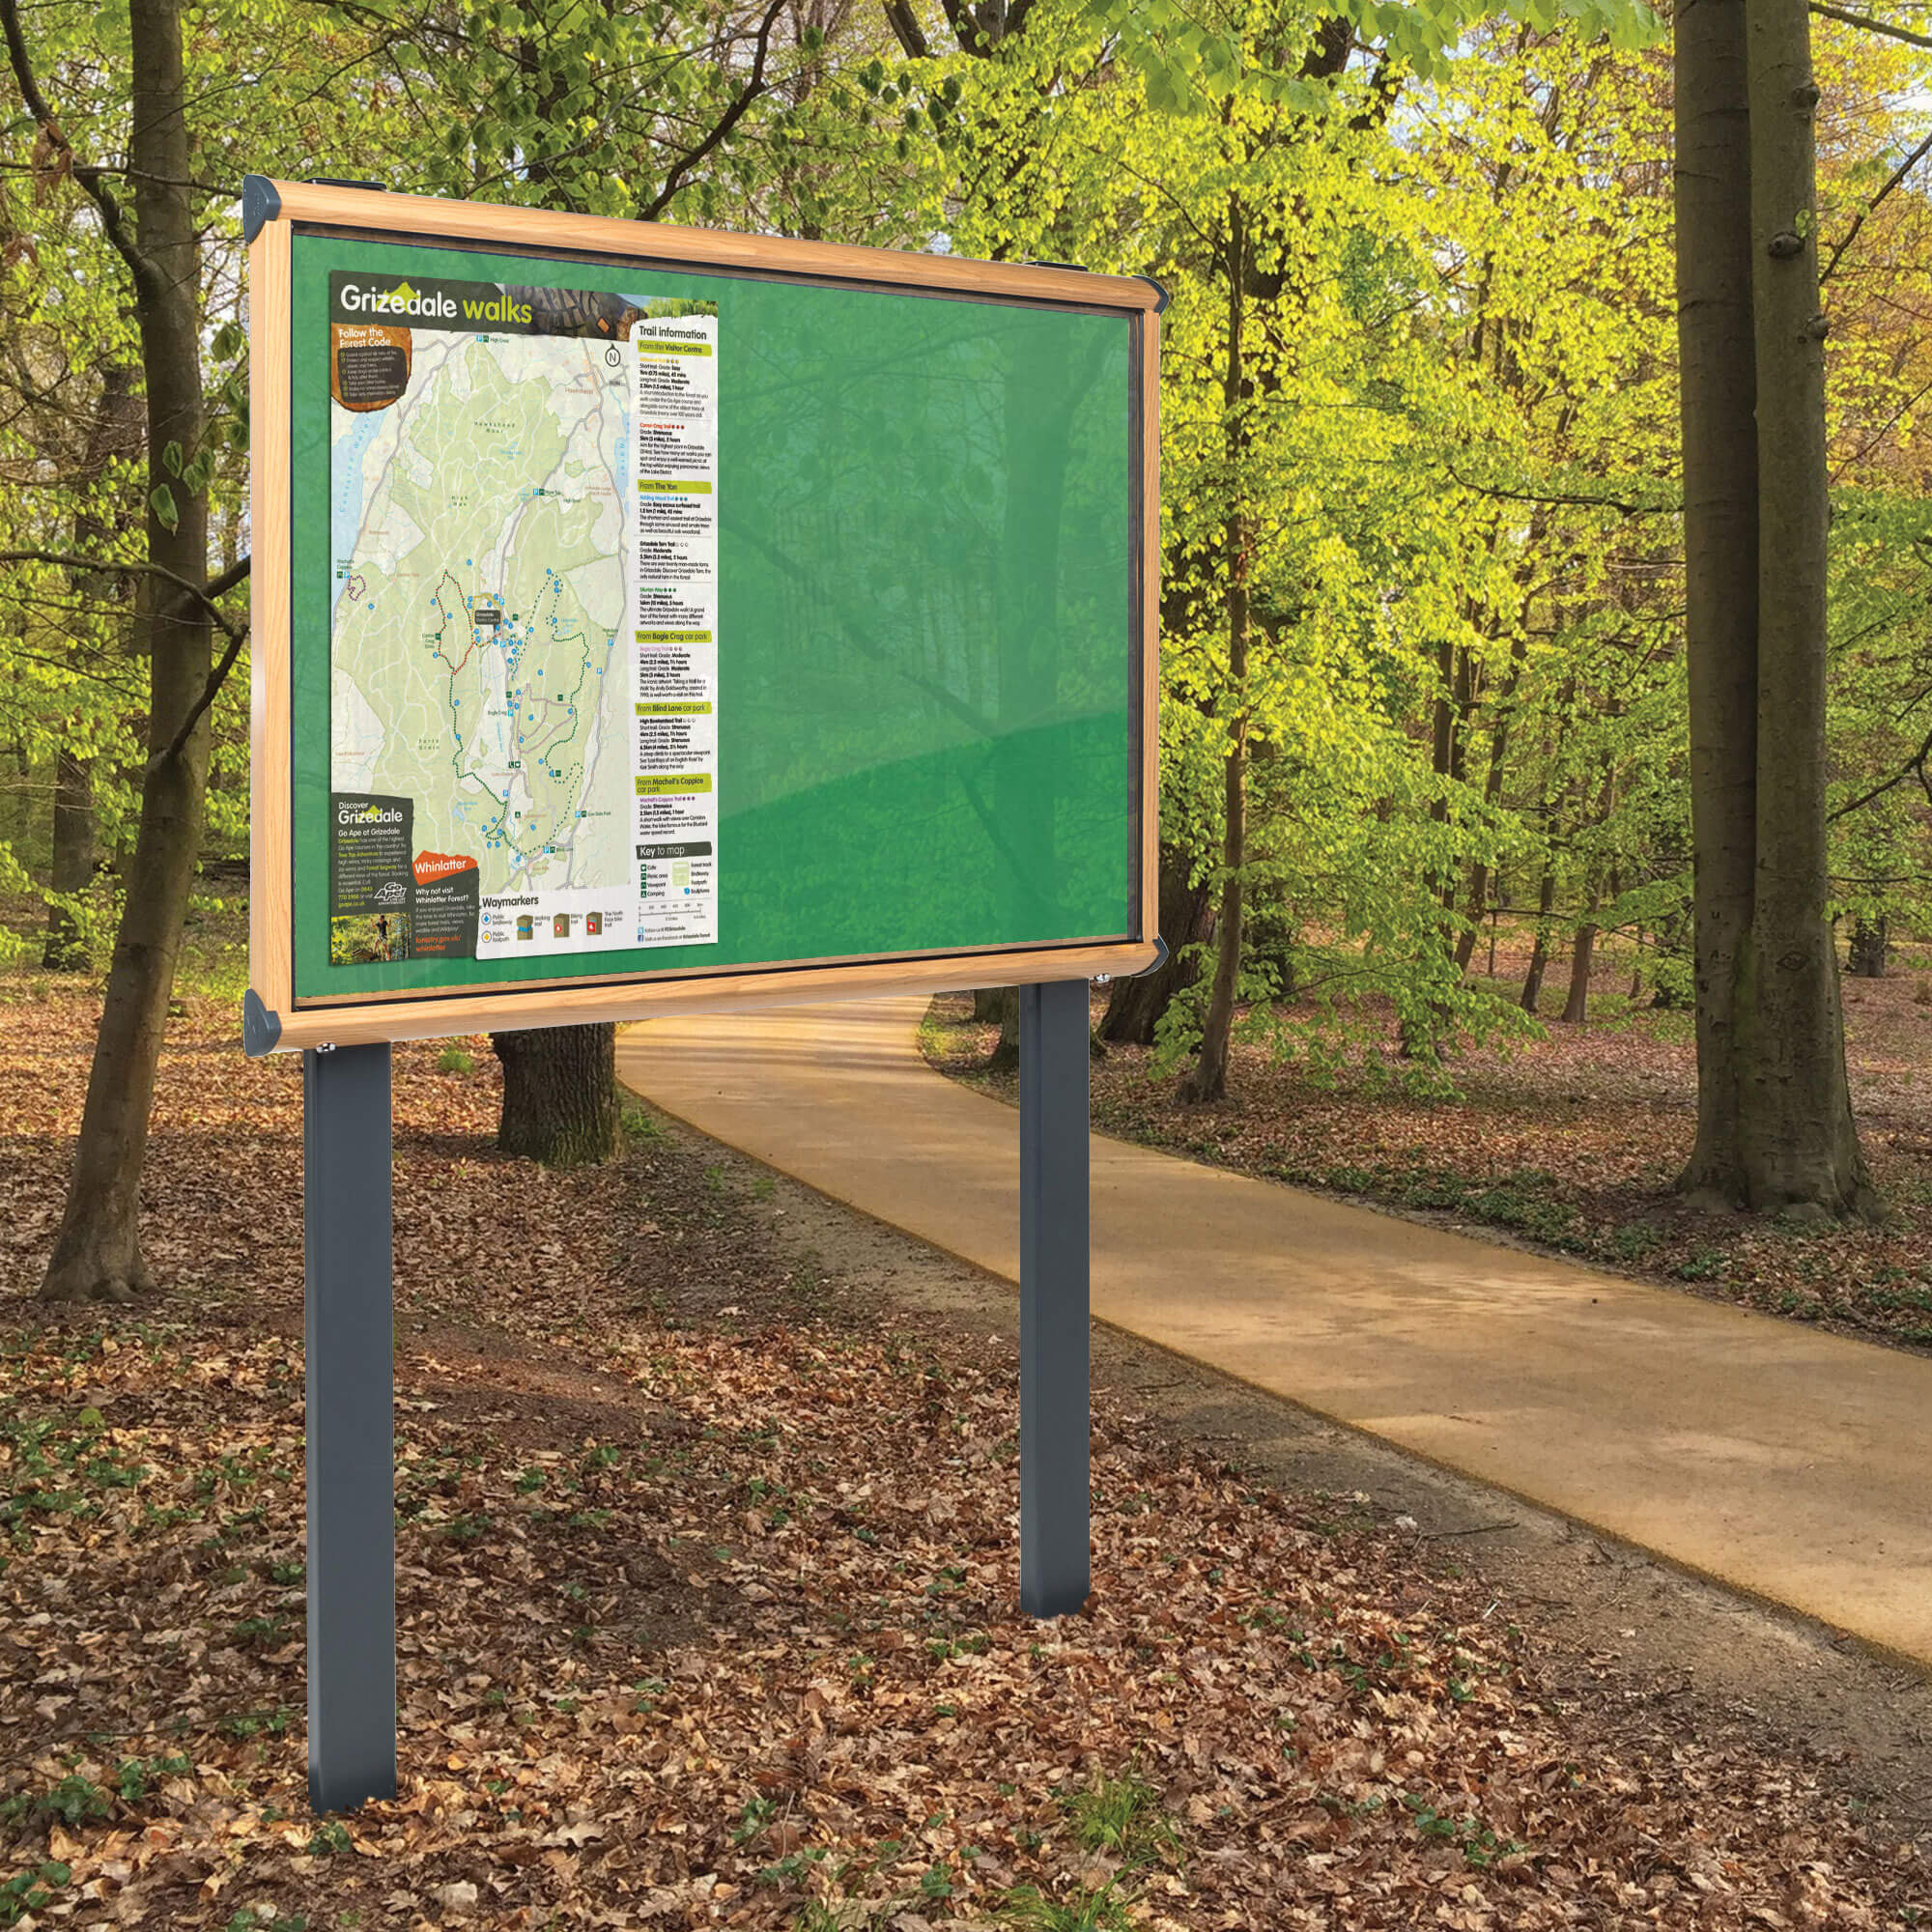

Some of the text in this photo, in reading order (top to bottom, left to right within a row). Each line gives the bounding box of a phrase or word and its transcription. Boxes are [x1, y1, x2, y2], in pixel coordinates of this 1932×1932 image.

[341, 284, 532, 324] Grizedale walks
[339, 327, 384, 338] Follow the
[639, 326, 707, 340] Trail information
[339, 337, 391, 348] Forest Code
[665, 343, 682, 352] Visitor
[609, 352, 616, 362] N
[652, 633, 668, 641] Bogle
[670, 633, 684, 641] Crag
[695, 633, 707, 641] park
[681, 777, 703, 785] Coppice
[338, 808, 403, 825] Grizedale
[371, 827, 401, 836] Grizedale
[640, 846, 685, 858] Key to map
[414, 859, 467, 874] Whinlatter
[415, 888, 429, 896] Why
[415, 896, 446, 905] Whinlatter
[482, 895, 539, 910] Waymarkers
